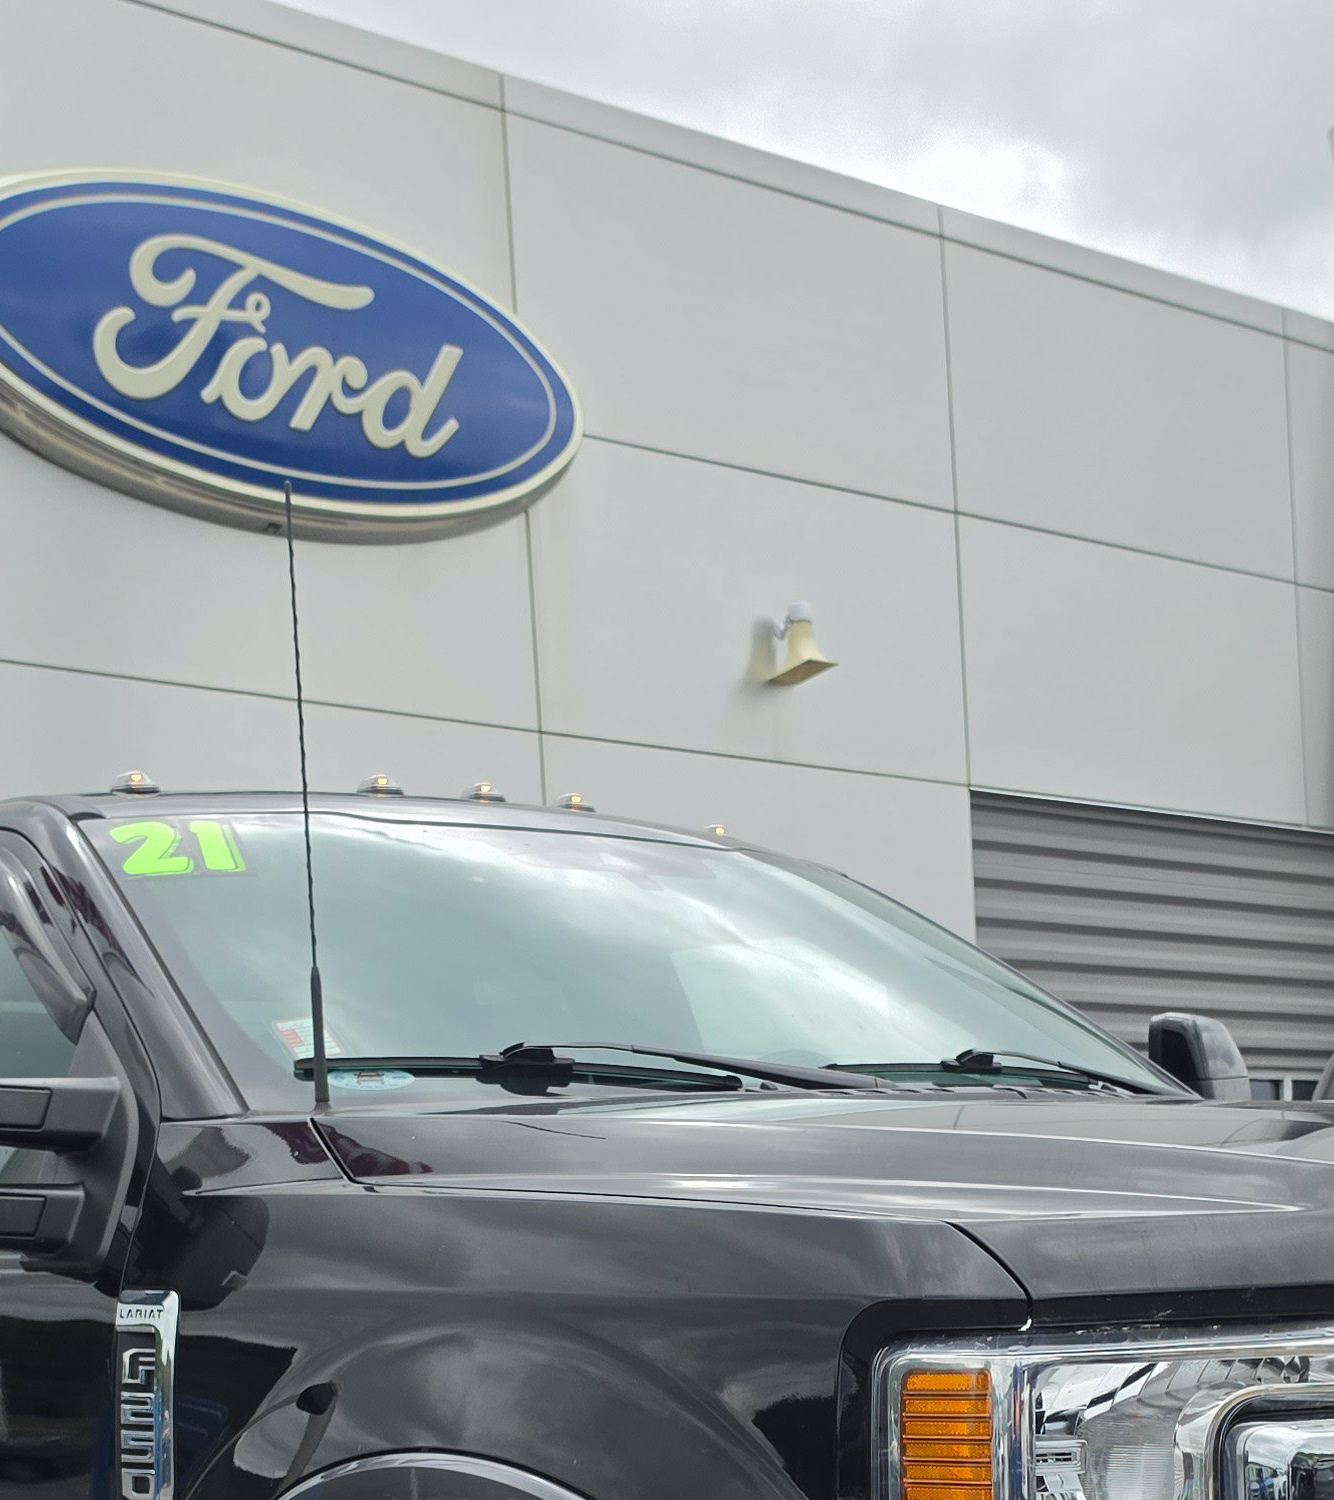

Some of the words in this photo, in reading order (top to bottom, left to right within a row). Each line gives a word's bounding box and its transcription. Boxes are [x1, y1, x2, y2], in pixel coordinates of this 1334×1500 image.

[93, 233, 465, 459] Ford
[108, 820, 246, 877] 21
[119, 1308, 164, 1320] LARIAT
